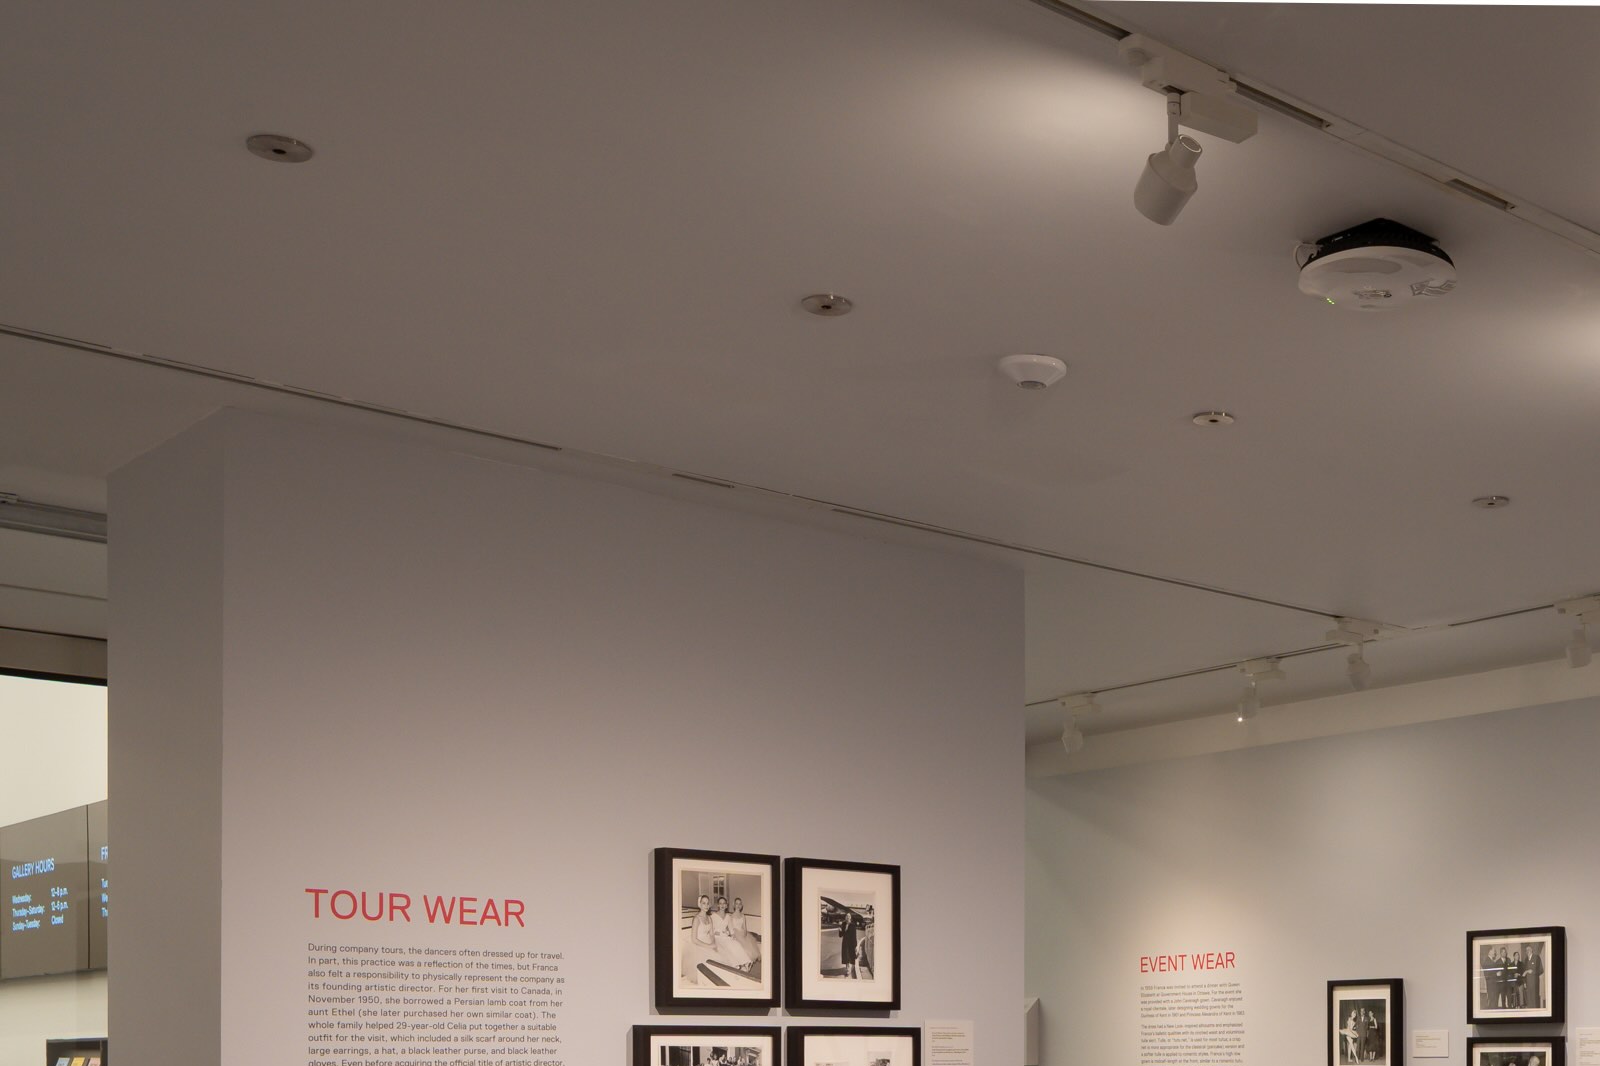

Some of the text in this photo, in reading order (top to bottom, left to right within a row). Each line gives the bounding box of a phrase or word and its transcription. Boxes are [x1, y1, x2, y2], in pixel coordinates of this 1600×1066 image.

[12, 858, 54, 878] GALLERY HOURS
[305, 888, 525, 928] TOUR WEAR
[307, 943, 564, 960] During company tours, the dancers often dressed up for travel.
[308, 956, 316, 964] In
[318, 956, 339, 966] part,
[342, 957, 358, 965] this
[360, 957, 395, 968] practice
[423, 959, 463, 969] reflection
[464, 961, 473, 969] of
[475, 961, 489, 969] the
[491, 961, 514, 972] times,
[516, 962, 529, 970] but
[532, 962, 558, 971] Franca
[1140, 952, 1235, 972] EVENT WEAR
[307, 968, 325, 977] also
[328, 969, 342, 978] felt
[352, 970, 409, 981] responsibility
[411, 972, 420, 980] to
[422, 972, 462, 983] physically
[464, 973, 502, 984] represent
[504, 974, 517, 982] the
[519, 976, 554, 985] company
[307, 982, 562, 997] its founding artistic director. For her first visit to Canada, in
[308, 995, 354, 1004] November
[358, 996, 382, 1006] 1950,
[385, 996, 400, 1005] she
[403, 997, 444, 1005] borrowed
[453, 997, 484, 1006] Persian
[487, 998, 506, 1006] lamb
[508, 998, 526, 1006] coat
[529, 998, 548, 1007] from
[550, 999, 562, 1007] her
[307, 1008, 328, 1016] aunt
[331, 1008, 355, 1017] Ethel
[358, 1008, 377, 1018] (she
[380, 1009, 400, 1017] later
[403, 1009, 447, 1019] purchased
[450, 1010, 463, 1018] her
[486, 1010, 511, 1018] similar
[514, 1010, 538, 1020] coat).
[542, 1011, 556, 1019] The
[308, 1021, 334, 1029] whole
[337, 1021, 363, 1031] family
[365, 1021, 393, 1031] helped
[396, 1022, 444, 1032] 29-year-old
[446, 1022, 467, 1030] Celia
[469, 1022, 482, 1032] put
[484, 1022, 517, 1033] together
[527, 1023, 556, 1031] suitable
[307, 1034, 332, 1042] outfit
[335, 1034, 348, 1042] for
[350, 1034, 364, 1042] the
[367, 1034, 388, 1044] visit,
[390, 1034, 413, 1042] which
[417, 1034, 451, 1042] included
[460, 1034, 473, 1043] silk
[475, 1034, 495, 1043] scarf
[497, 1035, 524, 1043] around
[526, 1035, 539, 1043] her
[541, 1035, 561, 1045] neck,
[308, 1047, 330, 1056] large
[332, 1047, 371, 1056] earrings,
[381, 1047, 398, 1056] hat,
[408, 1047, 430, 1055] black
[432, 1047, 460, 1055] leather
[463, 1048, 488, 1056] purse,
[490, 1047, 505, 1055] and
[507, 1047, 528, 1055] black
[530, 1047, 556, 1055] leather
[341, 1059, 362, 1066] Even
[364, 1059, 392, 1066] before
[434, 1059, 447, 1066] the
[449, 1059, 475, 1066] official
[478, 1059, 493, 1066] title
[494, 1059, 503, 1066] of
[505, 1059, 531, 1066] artistic
